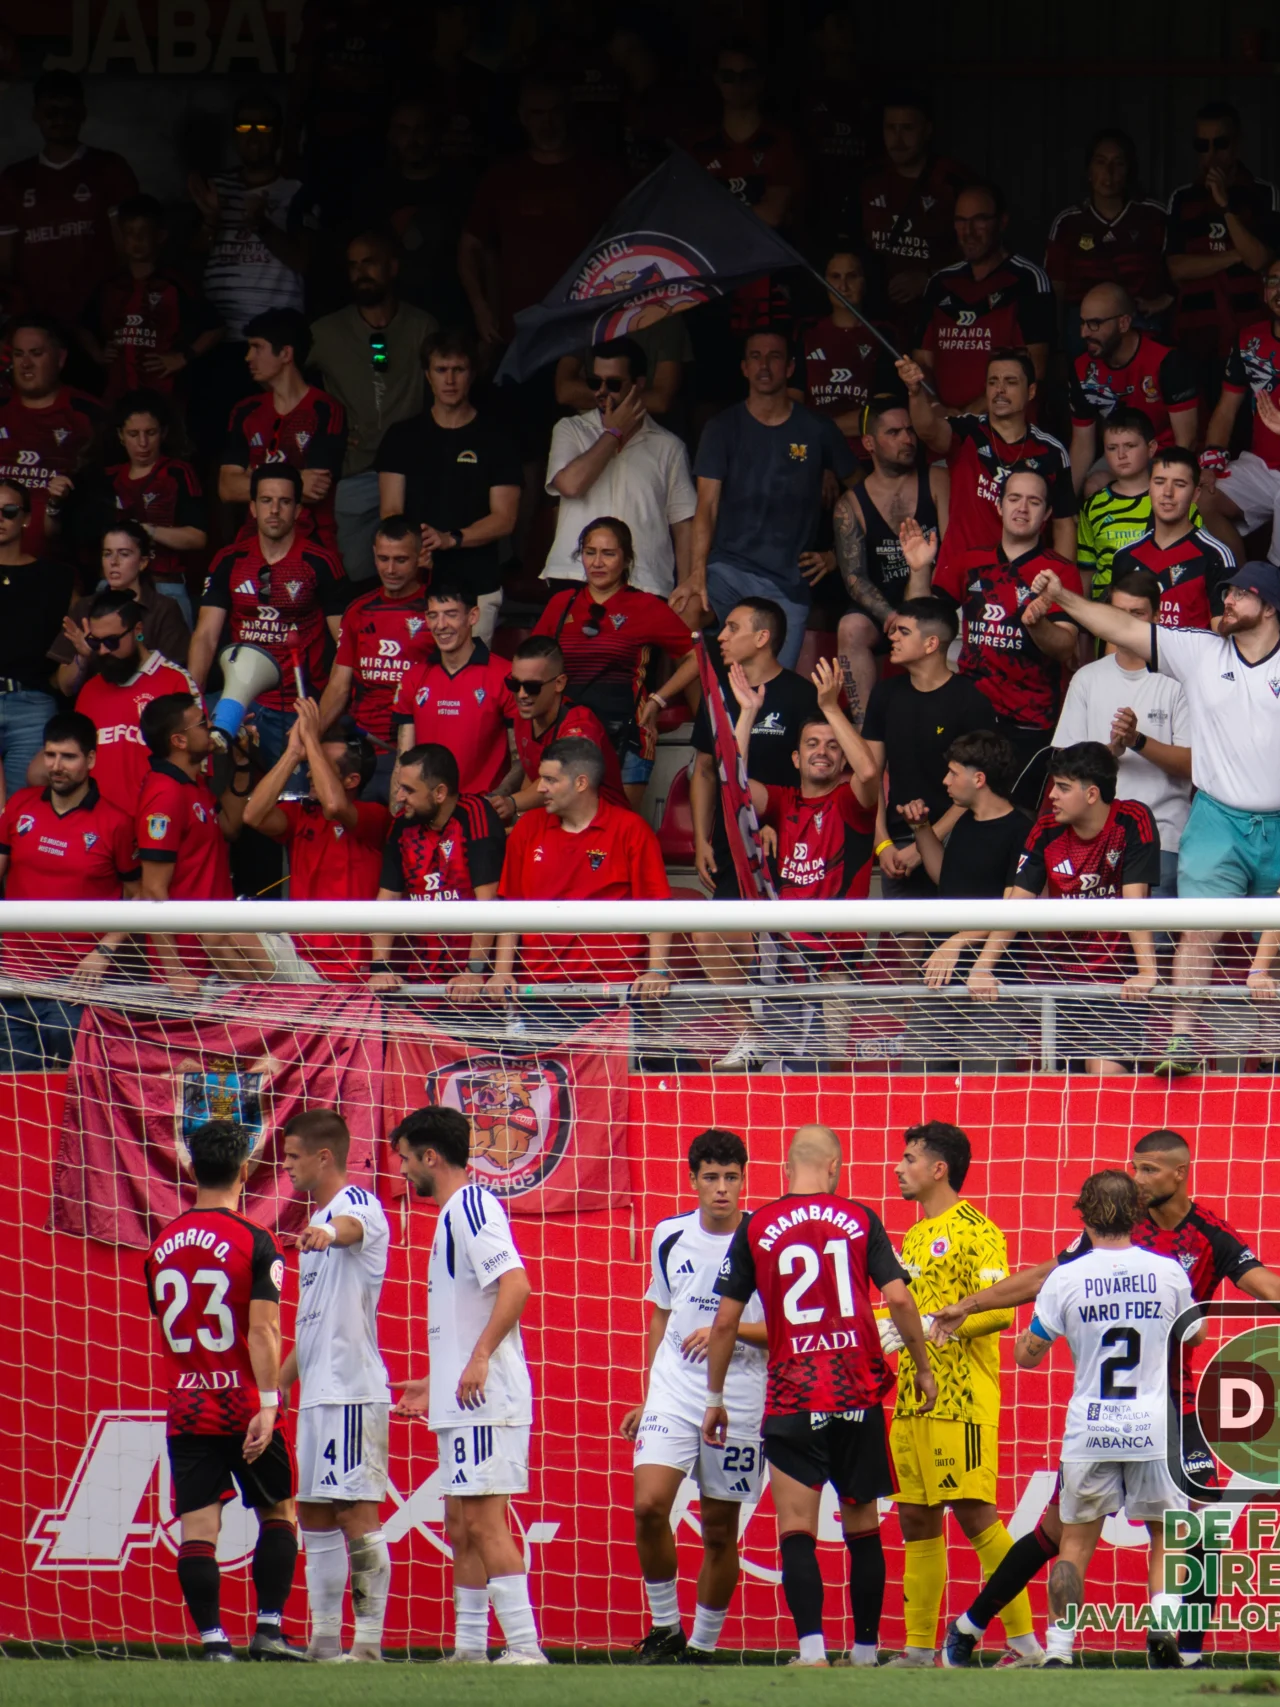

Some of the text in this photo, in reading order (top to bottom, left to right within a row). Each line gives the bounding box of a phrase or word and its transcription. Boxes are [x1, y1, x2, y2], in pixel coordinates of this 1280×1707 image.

[871, 231, 930, 249] MIANDA
[938, 327, 992, 339] MIRANDA
[1107, 529, 1145, 541] Emira
[242, 620, 298, 635] MIRANDA
[968, 620, 1023, 639] MIRANDA
[240, 630, 288, 644] EMPRES
[968, 634, 1023, 651] EMPRESAS
[360, 657, 412, 671] MIRAND
[361, 669, 405, 683] EMPRES
[757, 1204, 865, 1253] ARAMBARRI
[154, 1228, 229, 1265] DORRIO O.
[778, 1238, 855, 1326] 21
[1085, 1273, 1158, 1299] POVARELO
[690, 1295, 719, 1305] BricoCe
[155, 1269, 236, 1354] 23
[1079, 1301, 1164, 1323] VARO FDEZ.
[790, 1329, 859, 1355] IZADI
[1100, 1326, 1142, 1400] 2
[177, 1369, 240, 1392] IZADI
[1102, 1411, 1151, 1421] DE GALICIA
[1103, 1404, 1132, 1414] XUNTA
[1135, 1423, 1152, 1432] 2027
[323, 1438, 337, 1465] 4
[453, 1437, 467, 1464] 8
[722, 1445, 756, 1472] 23
[935, 1457, 956, 1467] CHITO
